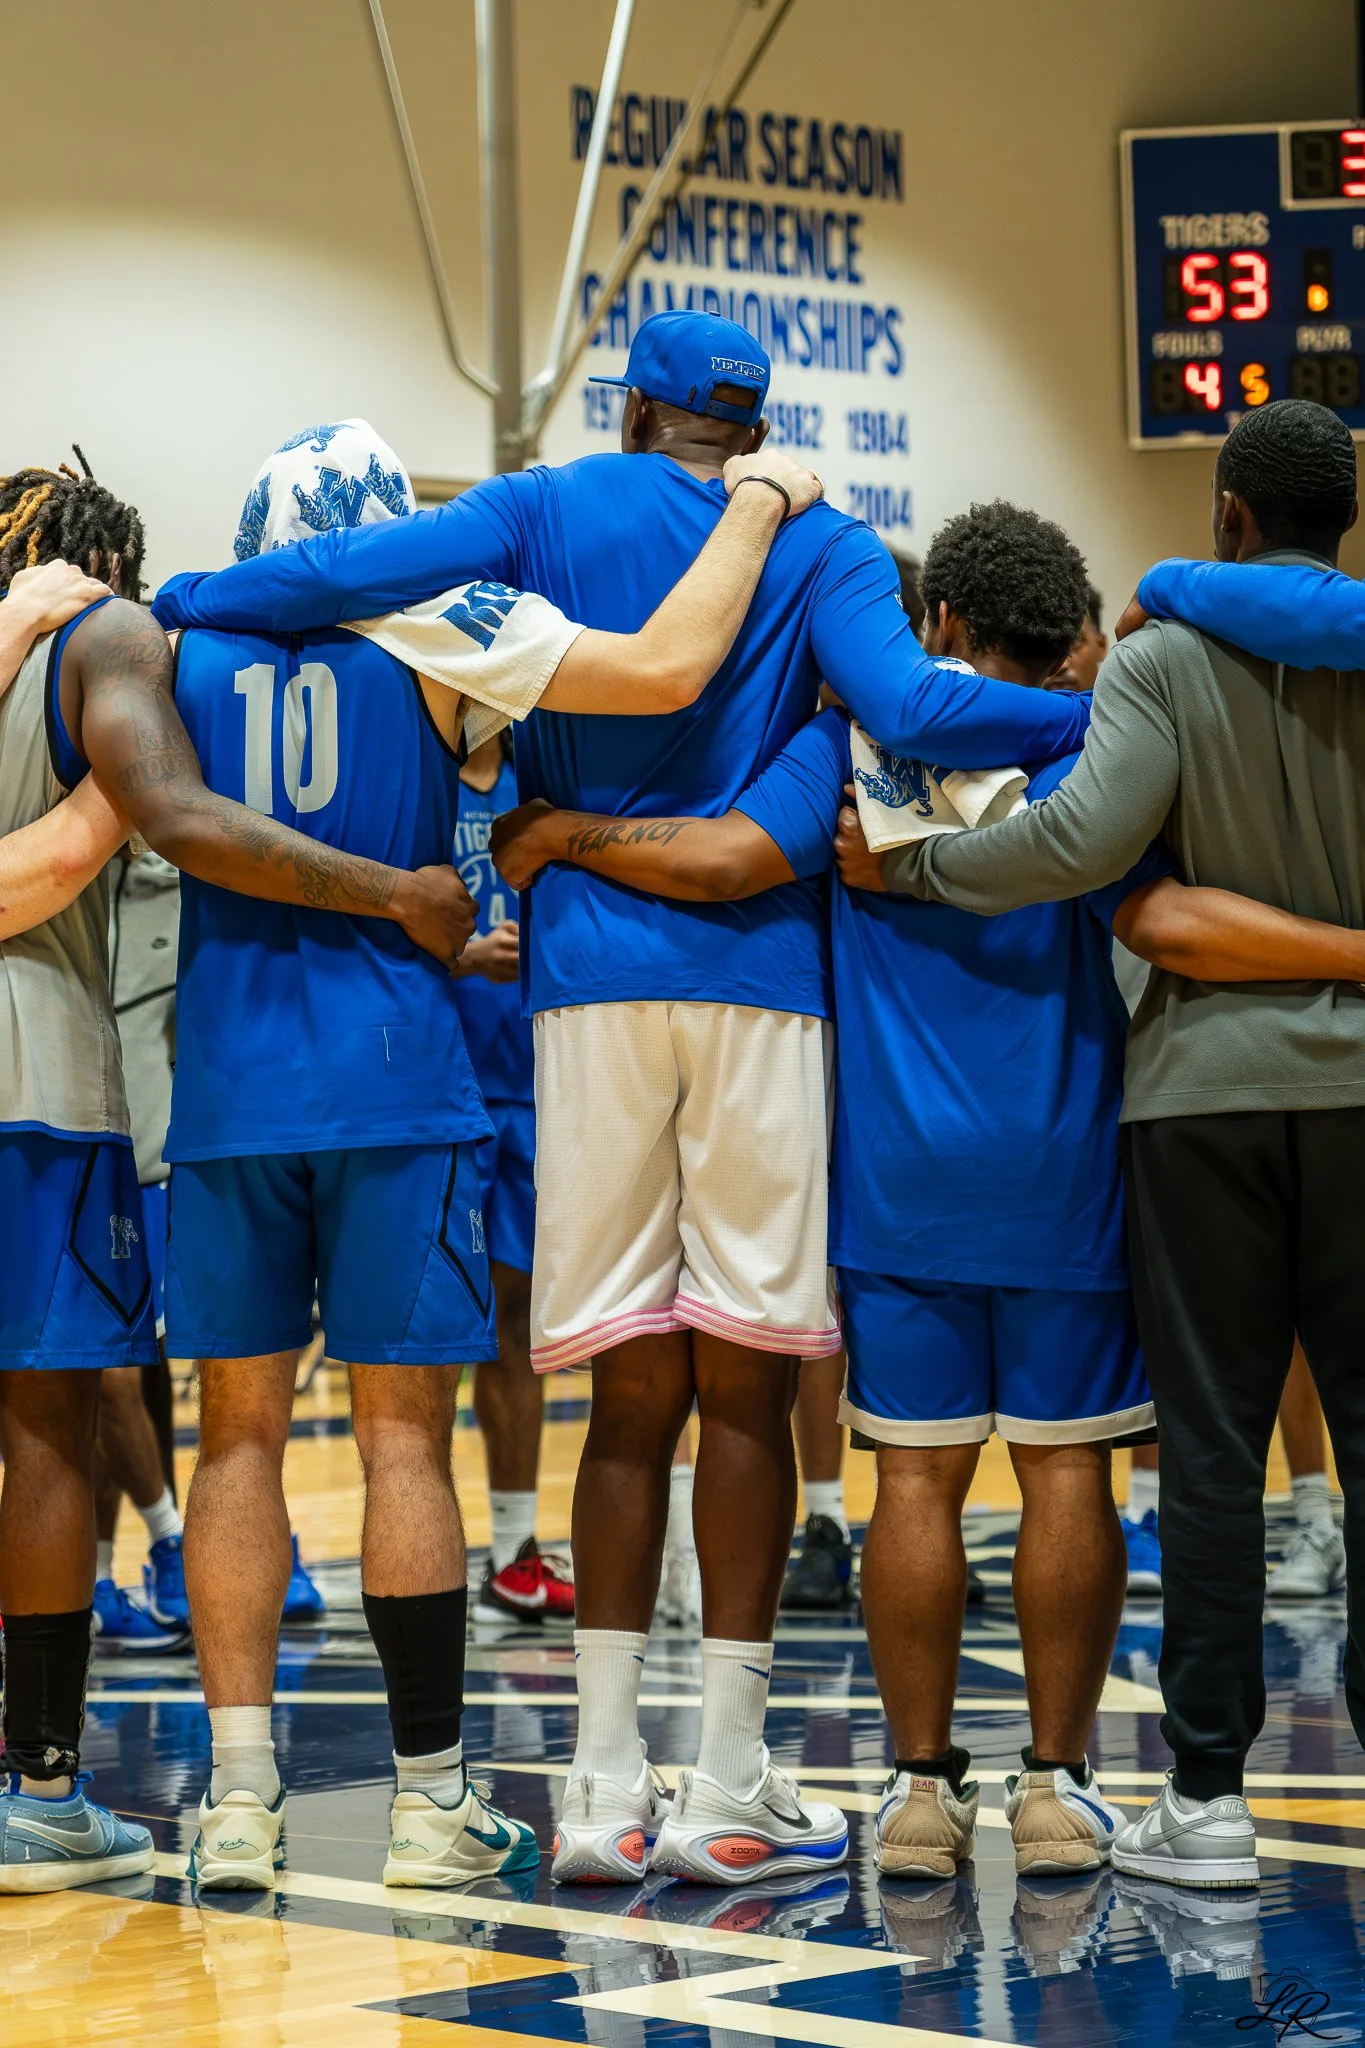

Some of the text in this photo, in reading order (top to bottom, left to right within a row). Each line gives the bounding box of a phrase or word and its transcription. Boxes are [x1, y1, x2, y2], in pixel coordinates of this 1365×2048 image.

[758, 112, 906, 203] SEASON
[1159, 211, 1270, 250] TIGERS
[1181, 251, 1269, 323] 53
[1184, 362, 1221, 411] 4
[234, 662, 339, 815] 10
[625, 821, 696, 848] NOT
[1218, 1801, 1243, 1815] NIKE
